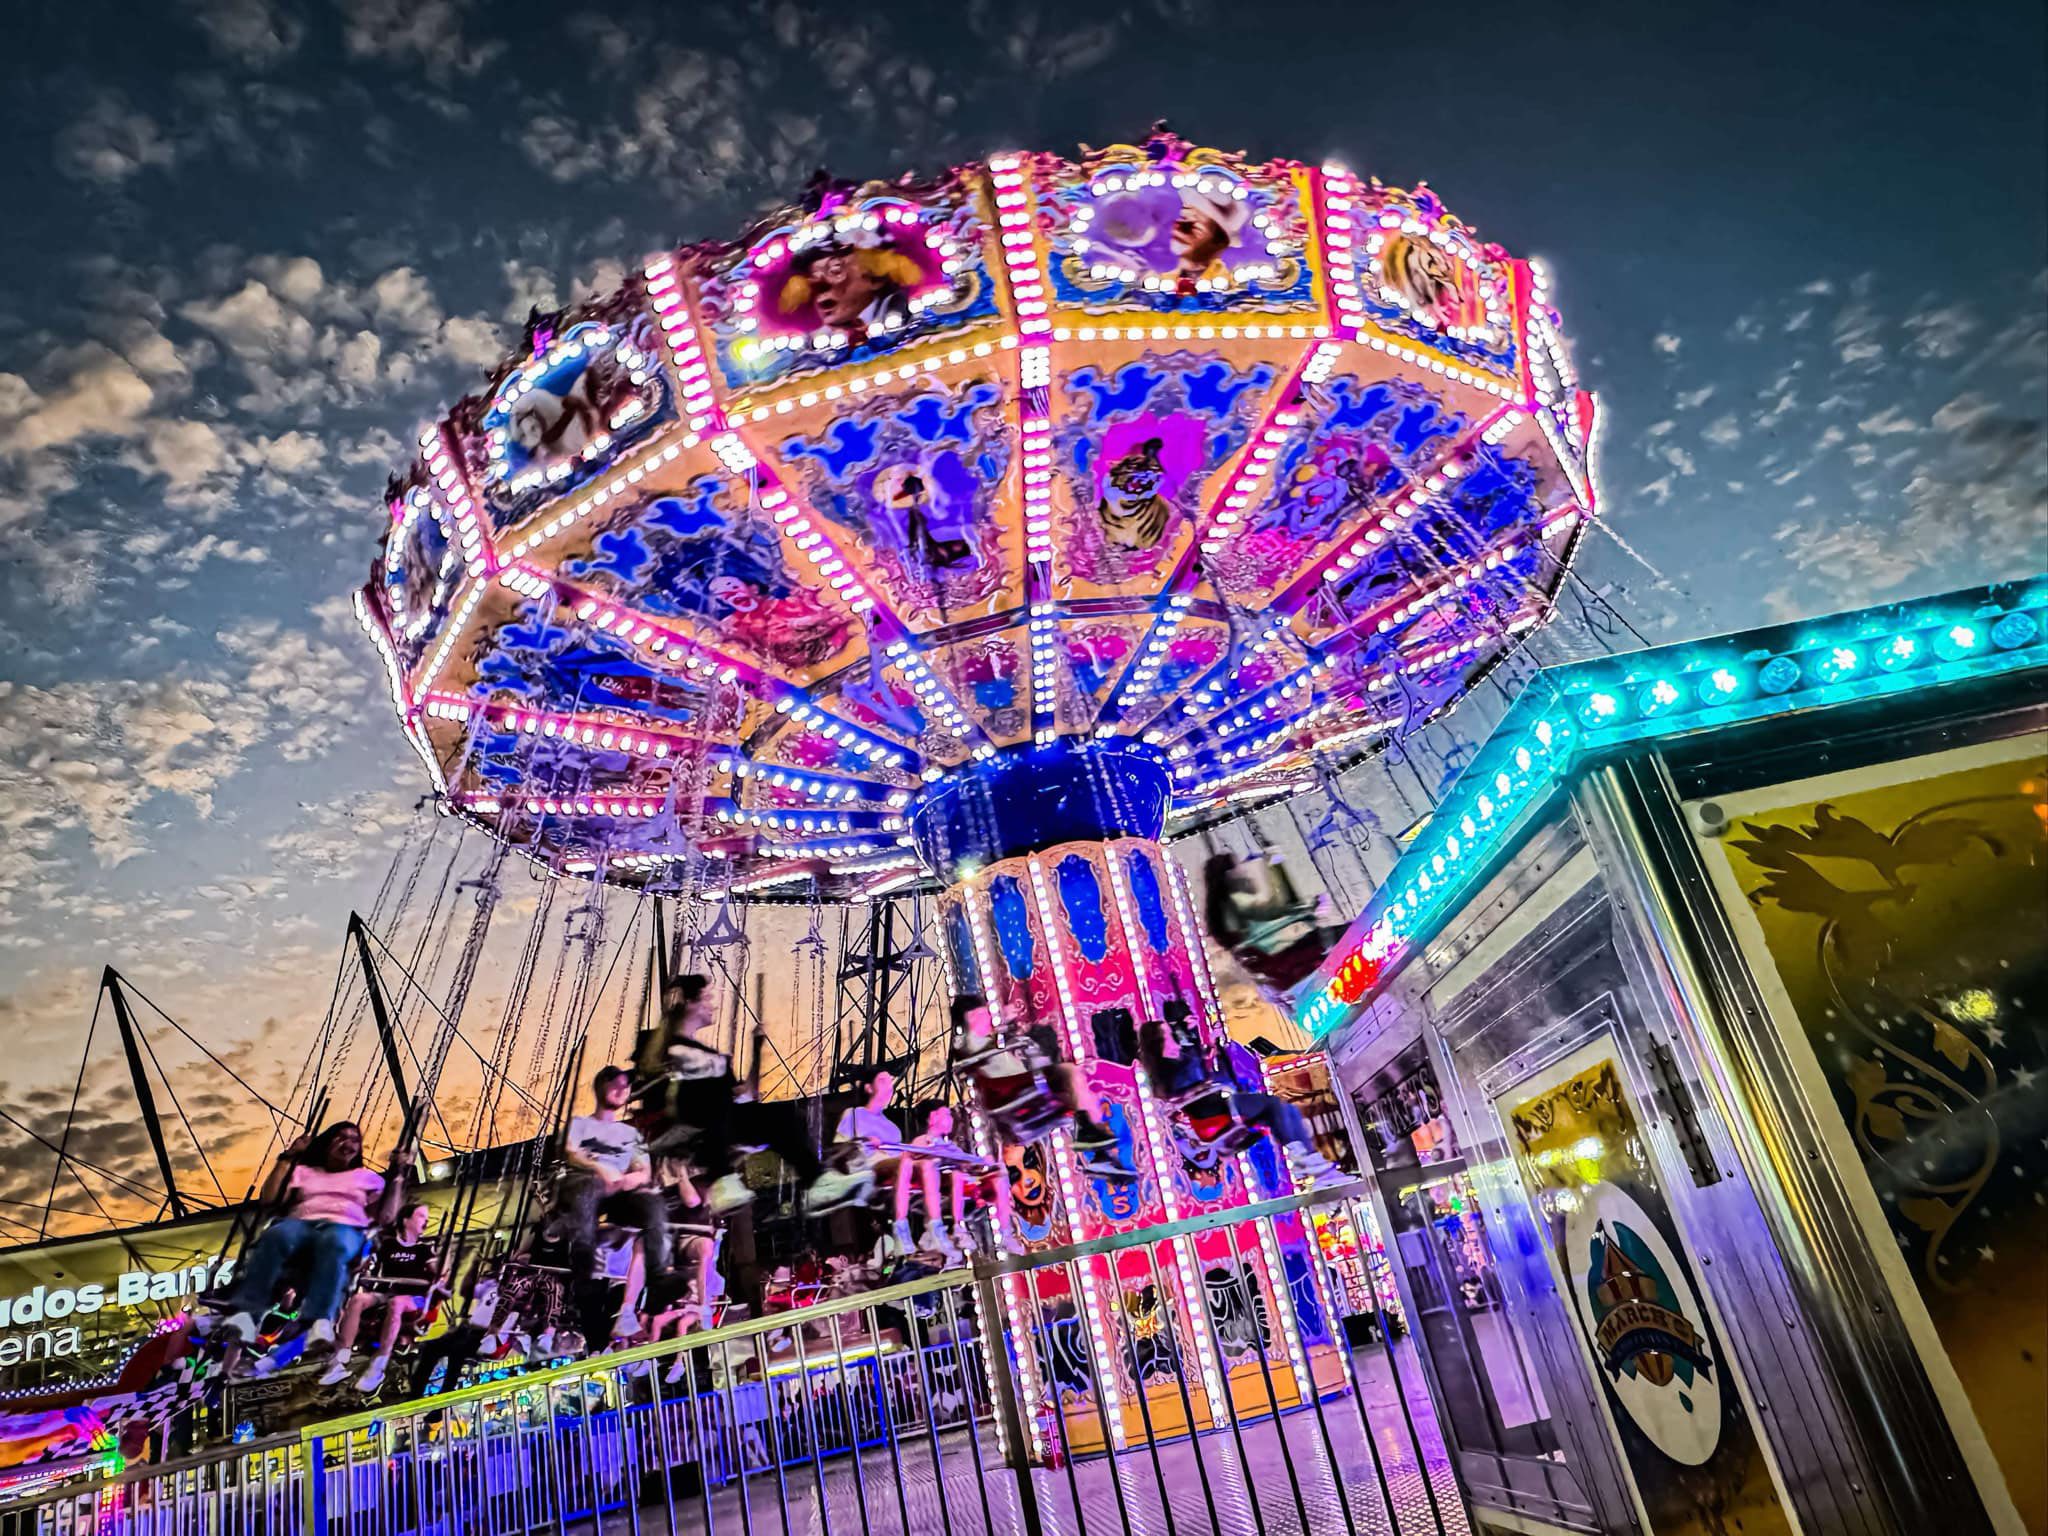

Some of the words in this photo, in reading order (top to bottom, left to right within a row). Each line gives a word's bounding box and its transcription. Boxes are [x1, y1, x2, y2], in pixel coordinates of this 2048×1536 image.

[1365, 1067, 1440, 1144] TICKETS
[118, 1255, 237, 1306] Bank
[0, 1326, 80, 1365] ena
